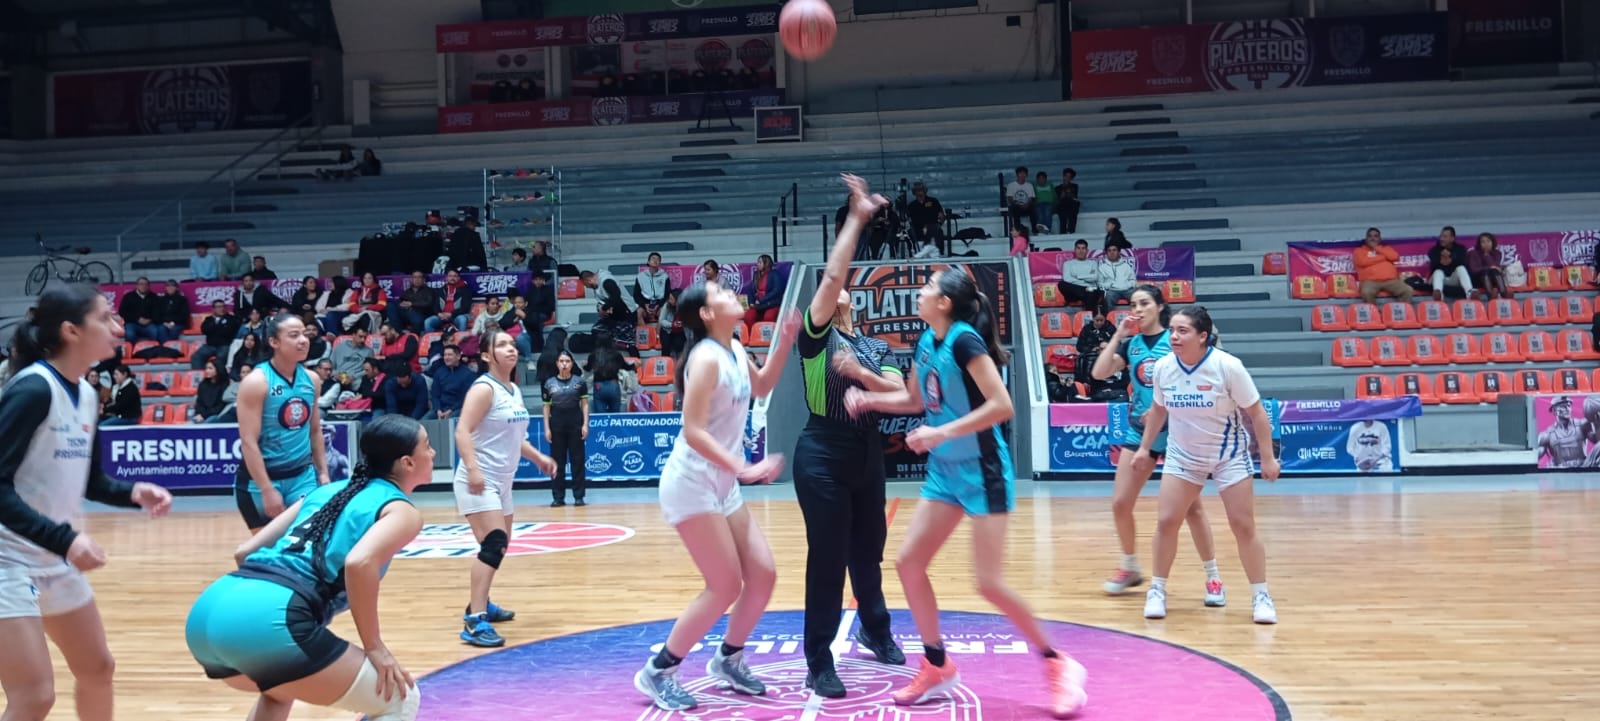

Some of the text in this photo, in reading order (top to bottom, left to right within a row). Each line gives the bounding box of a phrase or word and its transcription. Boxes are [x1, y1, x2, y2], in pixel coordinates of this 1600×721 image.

[587, 23, 625, 34] PLATEROS
[1465, 16, 1553, 33] FRESNILLO
[1210, 39, 1306, 67] PLATEROS
[1225, 64, 1292, 74] FRESNILLO
[1324, 67, 1372, 77] FRESNILLO
[1147, 76, 1193, 86] FRESNILLO
[144, 87, 231, 114] PLATEROS
[873, 321, 927, 334] FRESNI
[1172, 394, 1204, 402] TECNM
[116, 463, 185, 477] Ayuntamiento
[187, 463, 214, 475] 2024
[222, 463, 240, 475] 20
